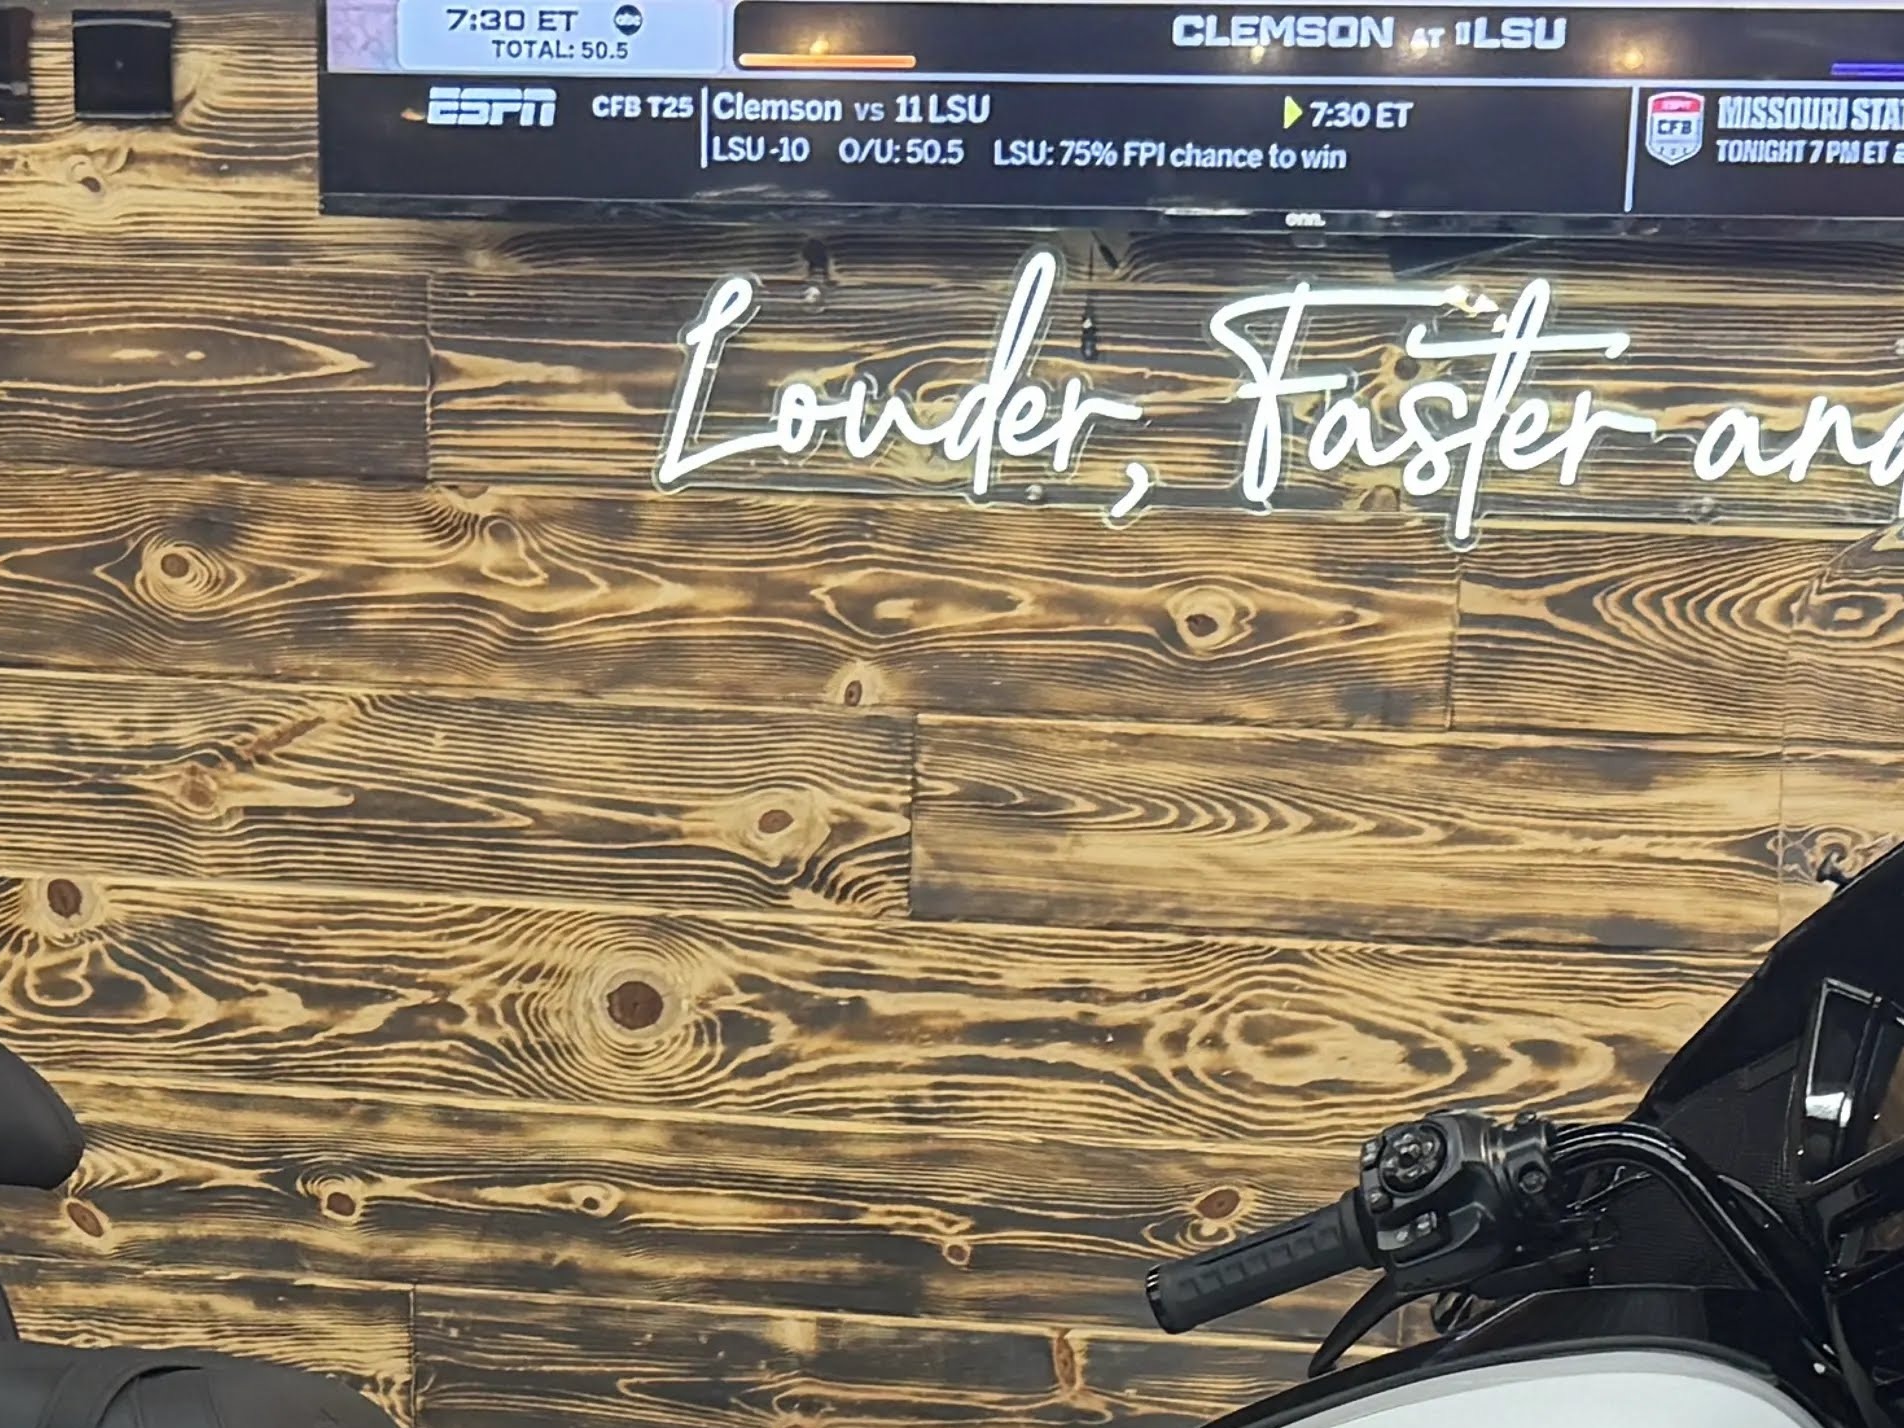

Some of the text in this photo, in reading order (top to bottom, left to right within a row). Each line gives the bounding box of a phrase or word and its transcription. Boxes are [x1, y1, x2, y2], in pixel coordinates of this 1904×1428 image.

[445, 9, 526, 32] 7:30
[537, 10, 579, 32] ET
[1172, 15, 1395, 48] CLEMSON
[1410, 27, 1446, 49] AT
[1473, 16, 1567, 50] LSU
[492, 39, 629, 60] TOTAL: 50.5
[426, 86, 557, 127] ESPN
[592, 95, 694, 119] CFB T25
[712, 92, 992, 125] Clemson vs 11 LSU
[1309, 102, 1414, 129] 7:30 ET
[1717, 96, 1849, 131] MISSOURI
[1657, 120, 1692, 135] CFB
[712, 136, 1347, 171] LSU -10 O/U: 50.5 LSU: 75% FPI chance to win
[1716, 139, 1807, 164] TONIGHT
[1809, 140, 1823, 164] 7
[1826, 141, 1860, 164] PM
[1863, 141, 1889, 164] ET
[658, 250, 1147, 518] Louder,
[1208, 277, 1664, 541] Faster
